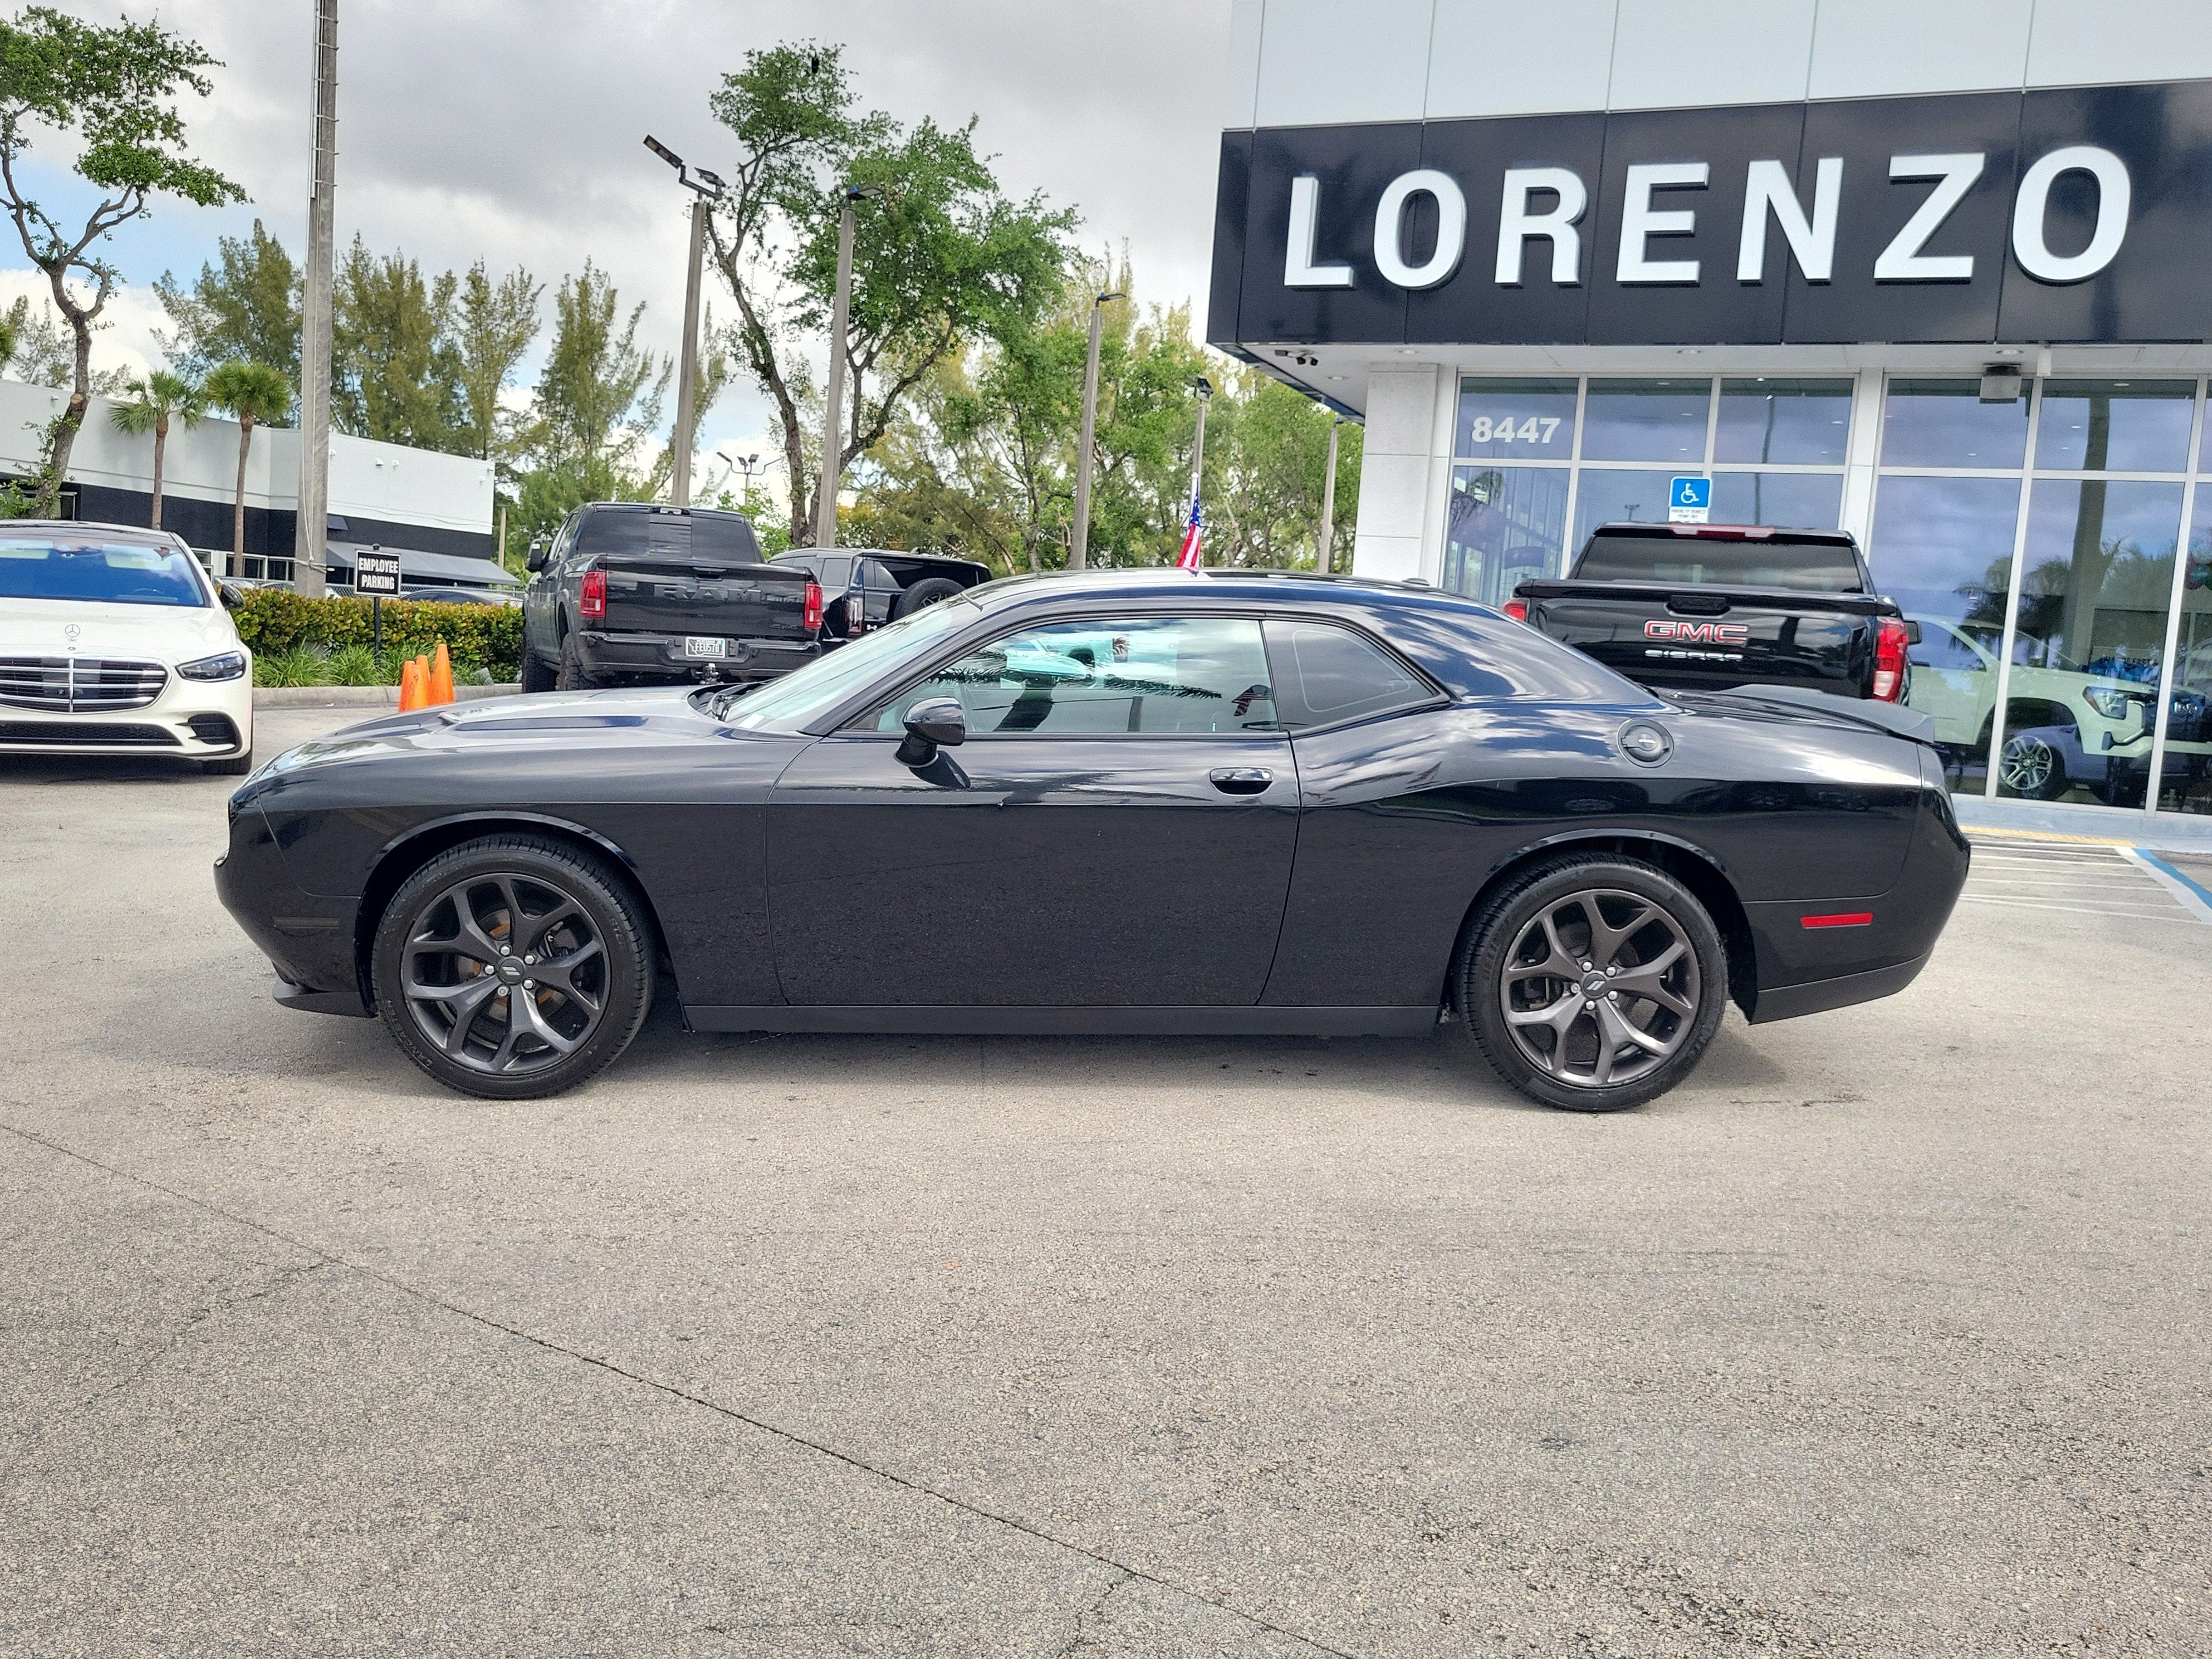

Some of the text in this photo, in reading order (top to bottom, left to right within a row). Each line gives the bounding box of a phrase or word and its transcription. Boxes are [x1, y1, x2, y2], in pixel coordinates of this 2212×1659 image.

[1284, 145, 2133, 290] LORENZO
[1471, 416, 1560, 443] 8447
[358, 557, 398, 573] EMPLOYEE
[362, 574, 394, 590] PARKING
[654, 584, 762, 602] RAM
[1644, 620, 1748, 645] GMC
